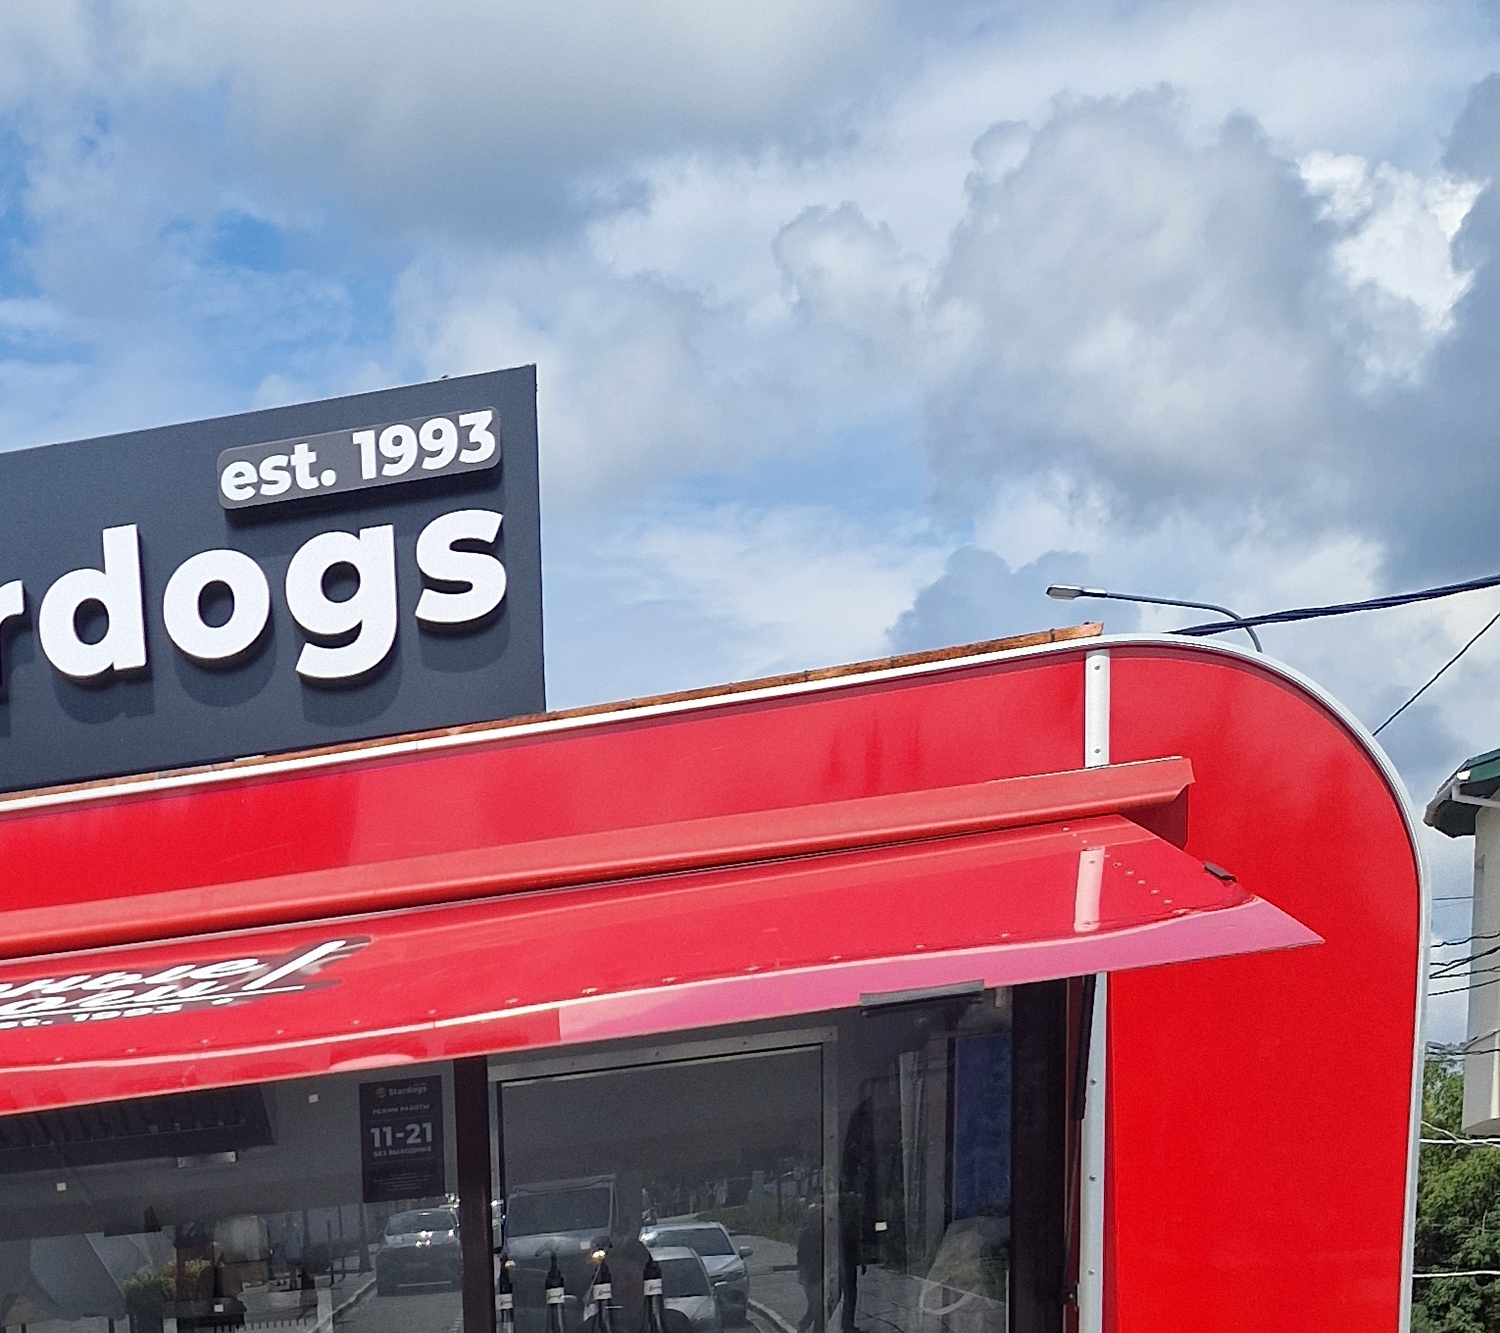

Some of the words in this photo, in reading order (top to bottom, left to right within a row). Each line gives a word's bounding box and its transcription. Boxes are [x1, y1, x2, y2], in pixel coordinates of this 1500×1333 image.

[219, 437, 337, 503] est.
[353, 407, 498, 481] 1993
[389, 1086, 427, 1096] Stardogs
[370, 1122, 432, 1148] 11-21
